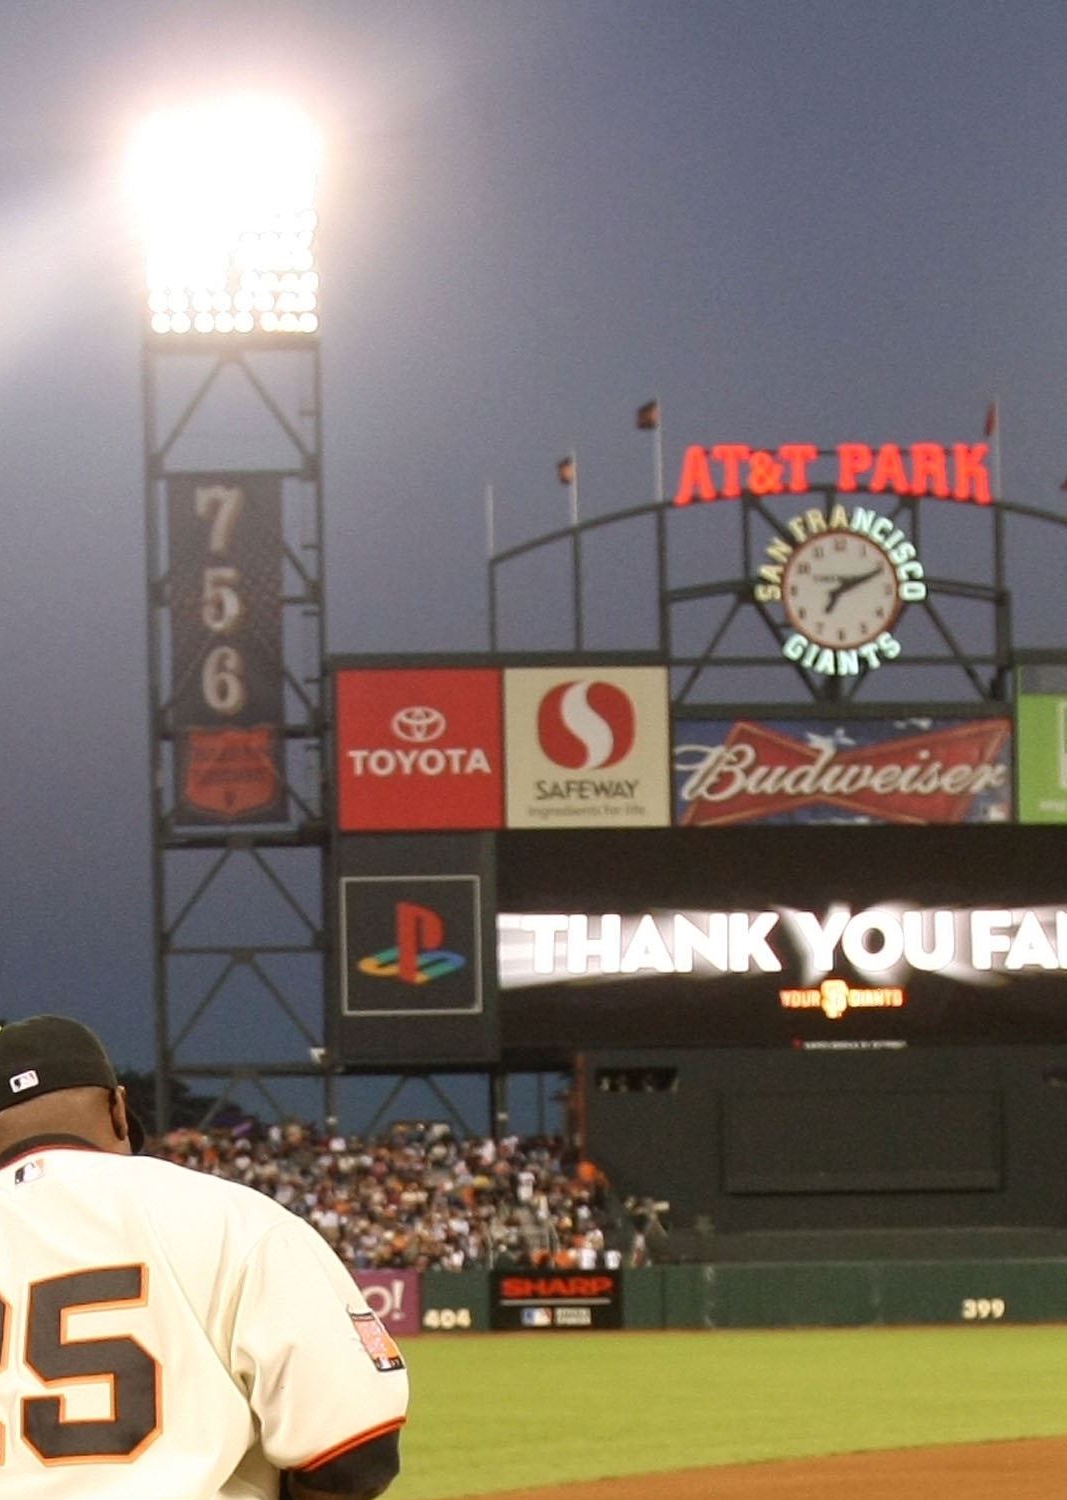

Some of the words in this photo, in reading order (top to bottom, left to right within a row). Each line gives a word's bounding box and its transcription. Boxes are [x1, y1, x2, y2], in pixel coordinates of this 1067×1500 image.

[674, 444, 819, 507] AT&T
[836, 443, 994, 505] PARK
[754, 537, 793, 602] SAN
[788, 504, 927, 601] FRANCISCO
[783, 632, 901, 675] GIANTS
[348, 748, 493, 776] TOYOTA
[673, 730, 1008, 801] Budweiser
[535, 779, 640, 801] SAFEWAY
[520, 911, 782, 974] THANK
[795, 909, 955, 973] YOU
[969, 909, 1067, 972] FA
[779, 989, 821, 1008] YOUR
[501, 1276, 613, 1298] SHARP
[423, 1308, 472, 1329] 404
[962, 1299, 1005, 1319] 399
